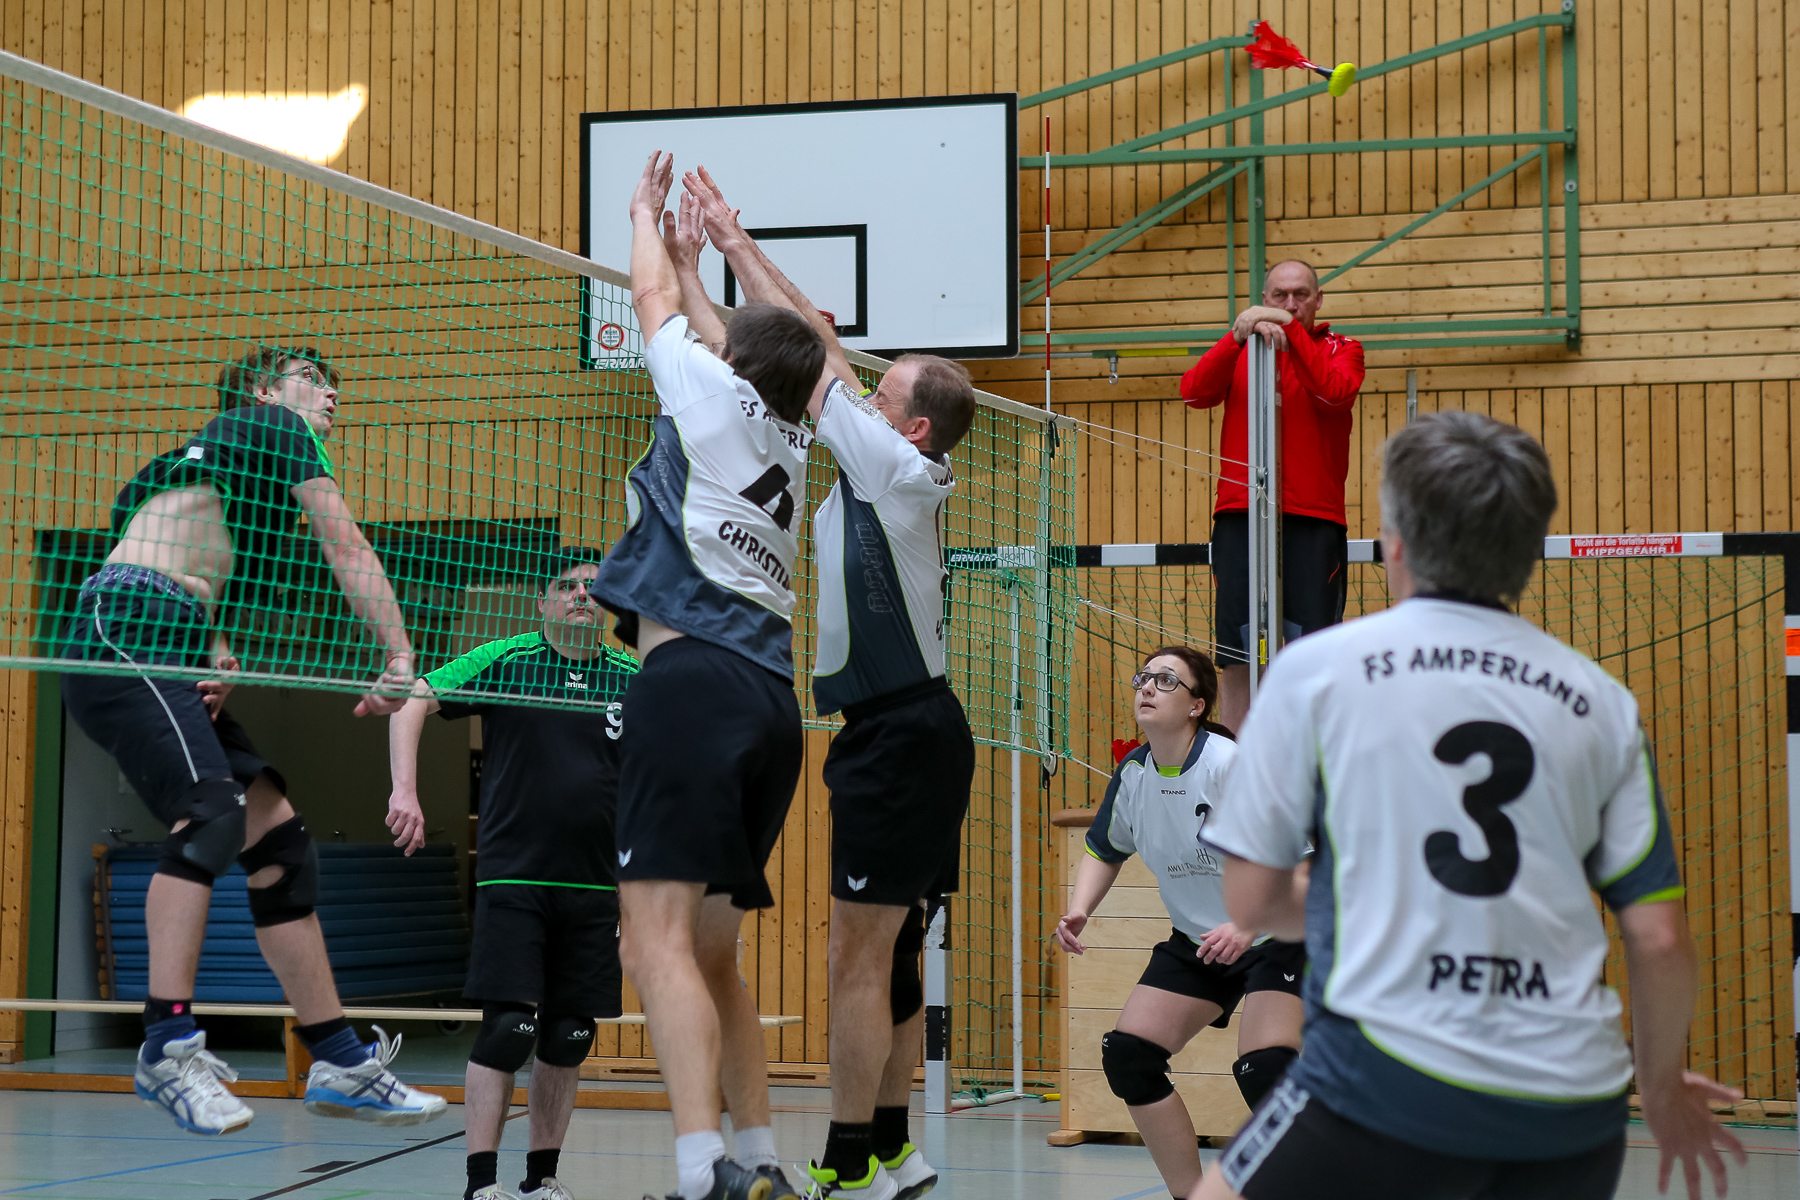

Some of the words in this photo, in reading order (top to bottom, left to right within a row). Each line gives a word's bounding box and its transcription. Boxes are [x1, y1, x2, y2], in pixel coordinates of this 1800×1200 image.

[594, 358, 646, 369] ERHAR
[1574, 539, 1593, 547] Nicht
[1605, 538, 1617, 546] die
[1586, 546, 1667, 556] KIPPGEFAHR
[565, 681, 588, 690] erima
[1362, 651, 1395, 683] FS
[1409, 647, 1591, 718] AMPERLAND
[605, 702, 623, 740] 9
[1424, 720, 1535, 898] 3
[1429, 954, 1550, 999] PETRA
